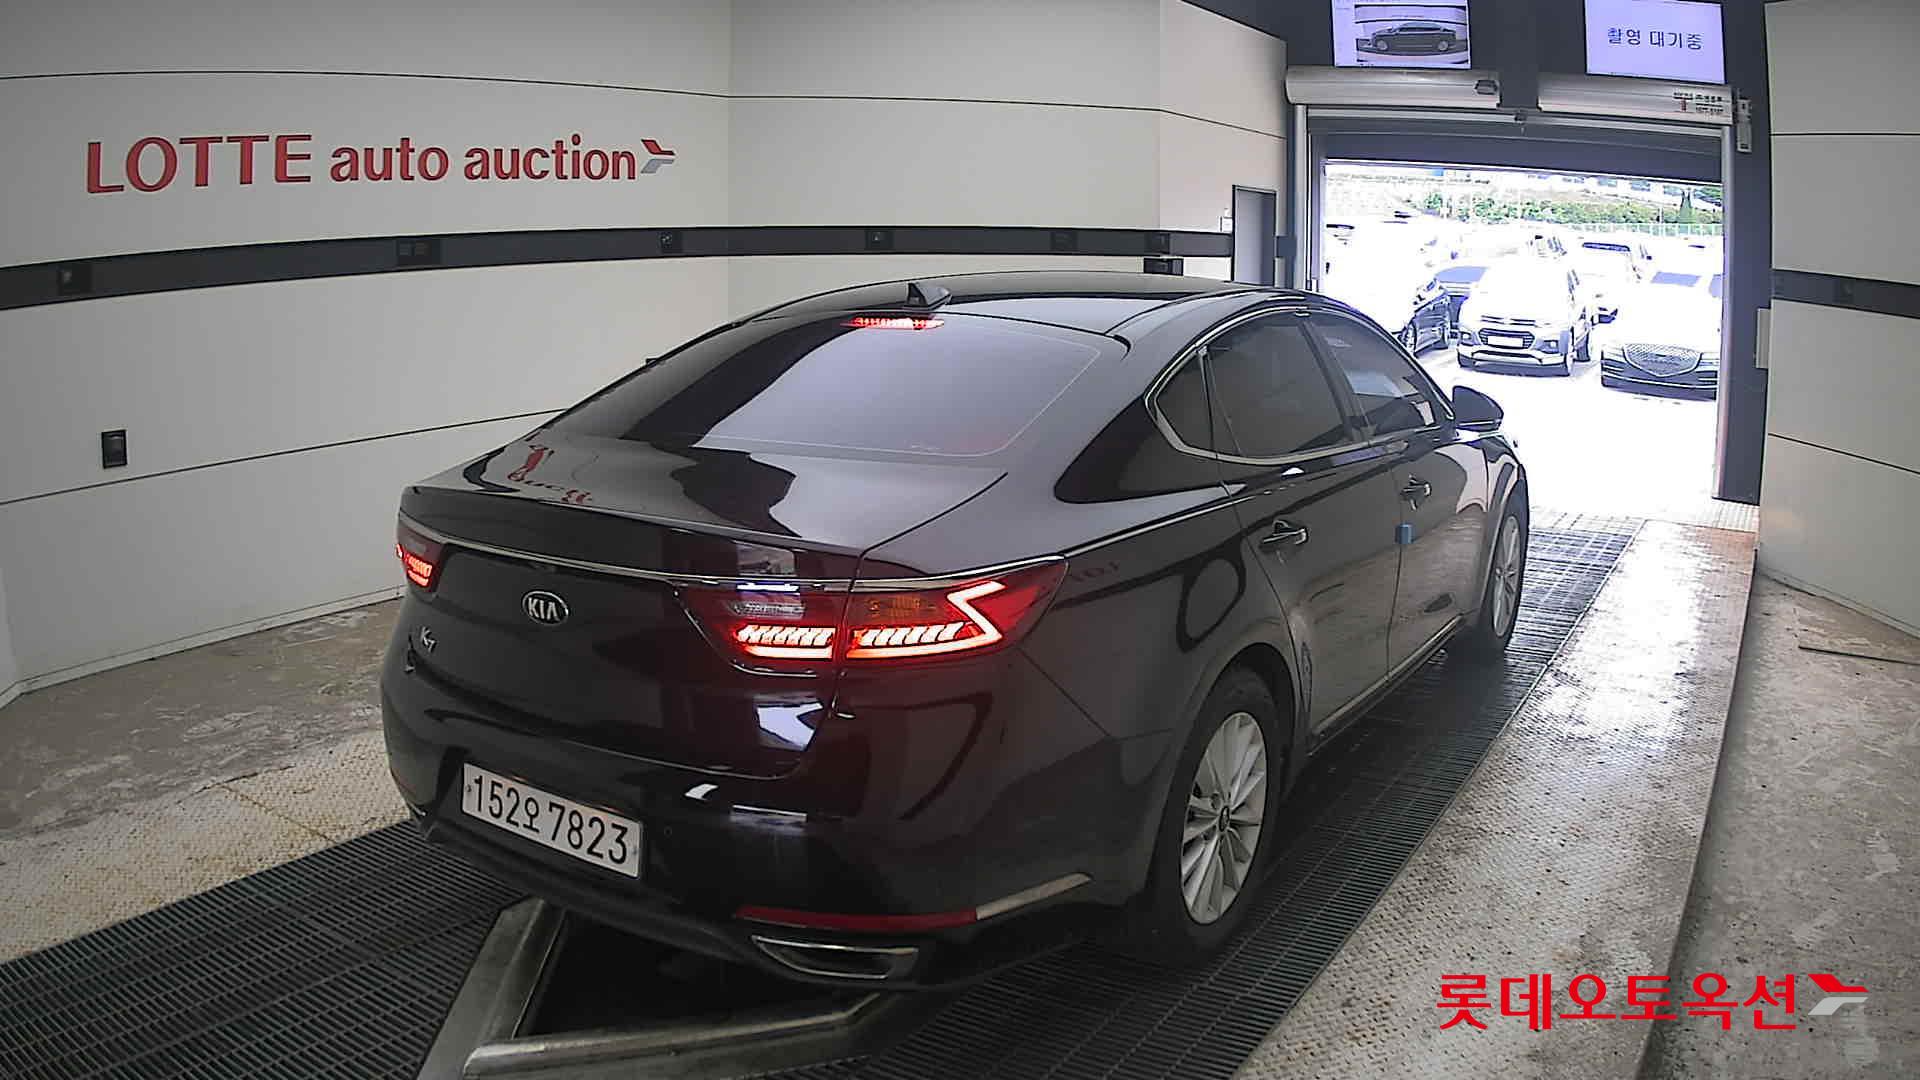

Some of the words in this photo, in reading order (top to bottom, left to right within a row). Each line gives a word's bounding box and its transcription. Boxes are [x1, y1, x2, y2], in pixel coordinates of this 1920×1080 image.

[1607, 28, 1641, 46] 촬영
[1649, 31, 1702, 50] 대기중
[87, 135, 312, 193] LOTTE
[330, 137, 450, 182] auto
[463, 134, 636, 181] auction
[527, 597, 561, 622] KIA
[420, 626, 436, 652] K7
[474, 775, 540, 833] 152오
[549, 801, 629, 865] 7823
